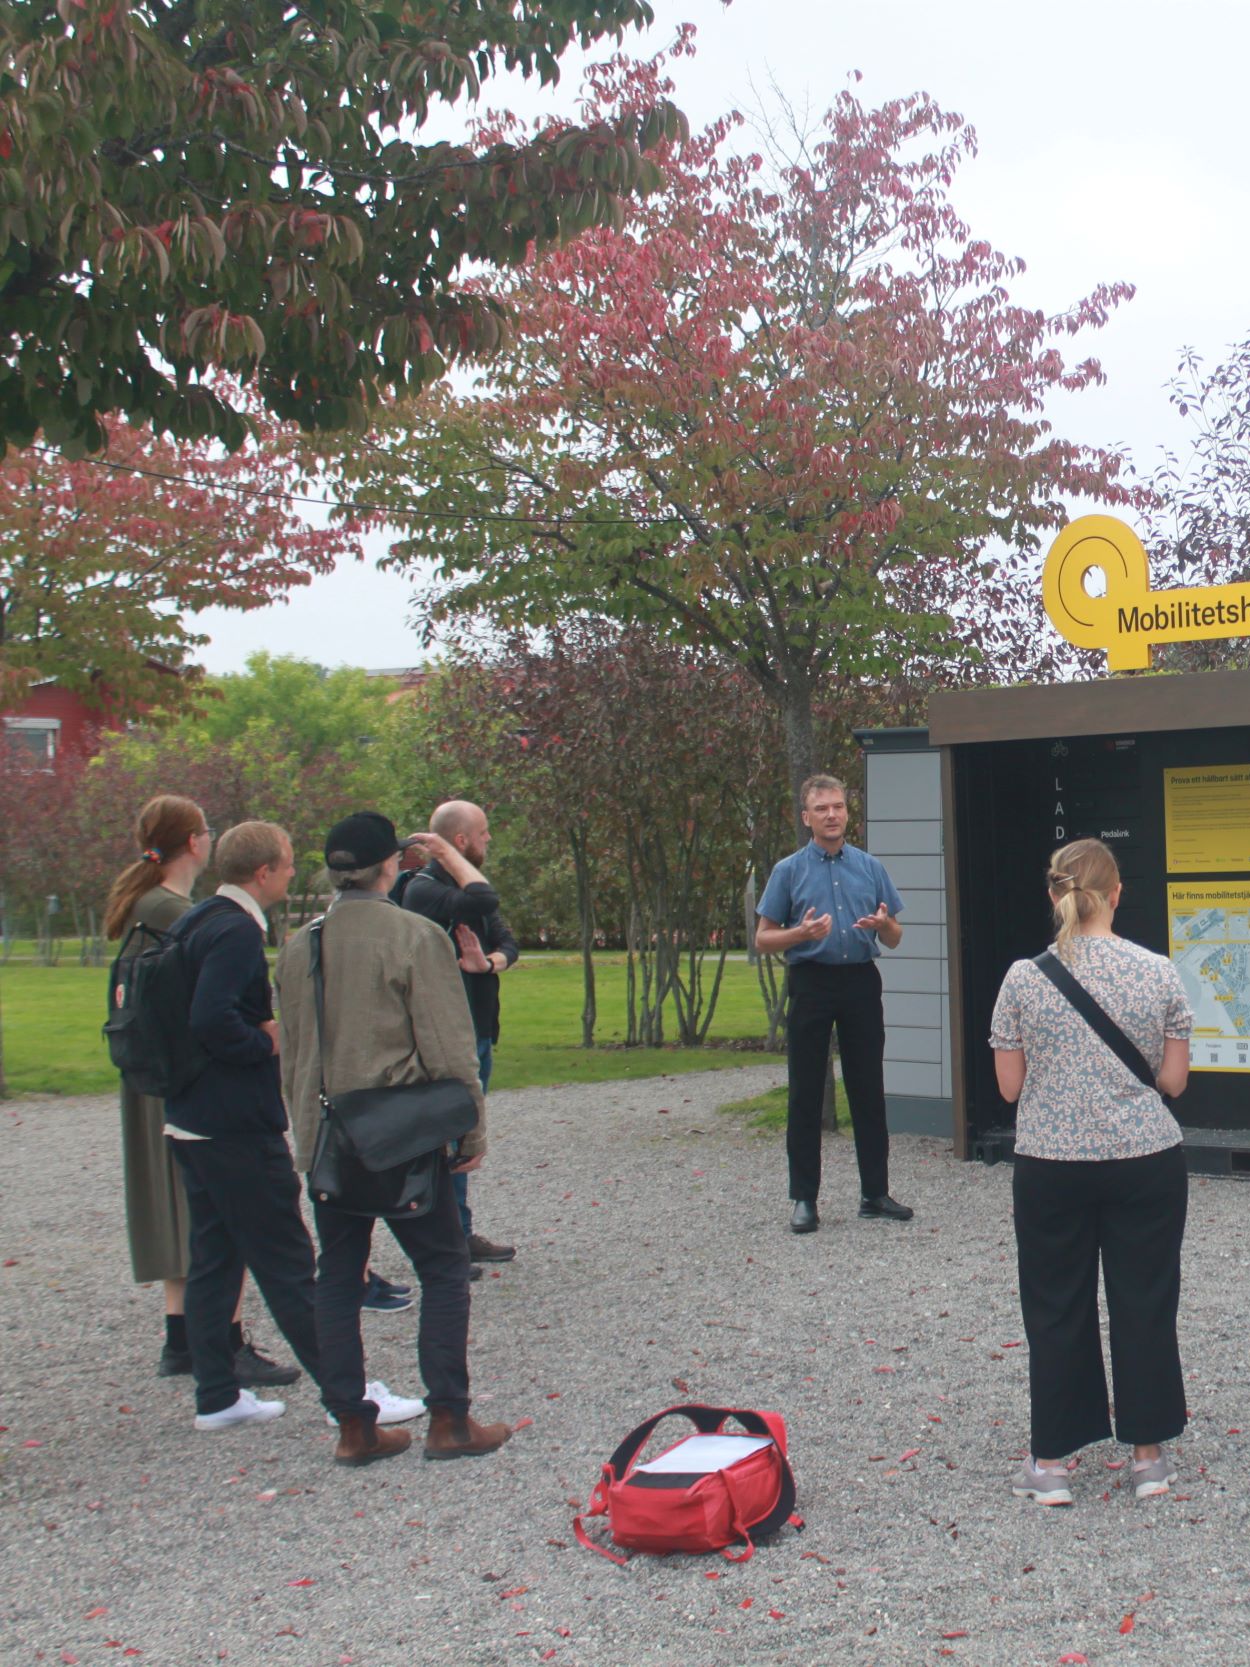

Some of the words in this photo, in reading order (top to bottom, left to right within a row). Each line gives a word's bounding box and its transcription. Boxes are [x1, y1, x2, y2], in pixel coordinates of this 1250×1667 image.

[1171, 775, 1191, 785] Prova
[1191, 775, 1201, 784] ett
[1202, 773, 1229, 783] hållbart
[1230, 773, 1244, 782] sätt
[1172, 890, 1185, 900] Här
[1186, 890, 1204, 900] finns
